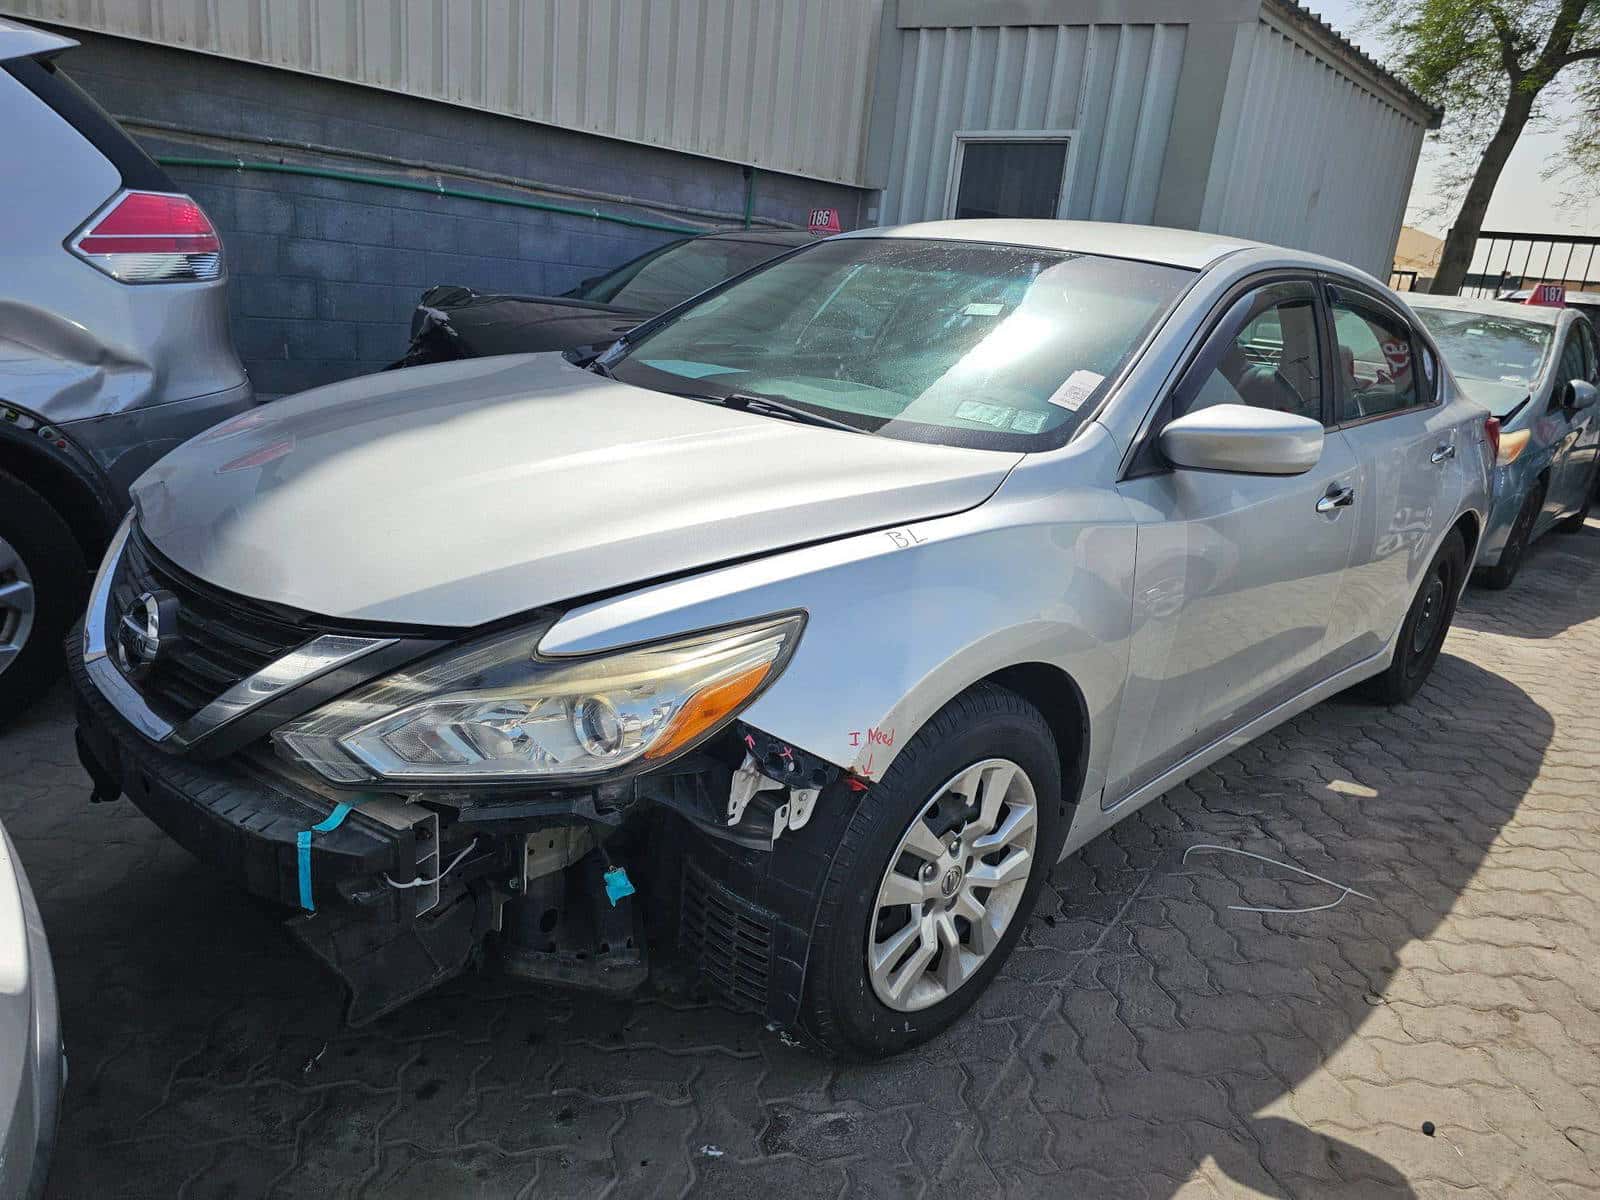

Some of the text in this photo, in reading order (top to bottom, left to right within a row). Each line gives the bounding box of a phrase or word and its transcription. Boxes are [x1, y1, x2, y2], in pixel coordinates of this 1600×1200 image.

[811, 209, 830, 226] 186
[1544, 286, 1563, 302] 187
[849, 727, 895, 747] I Need
